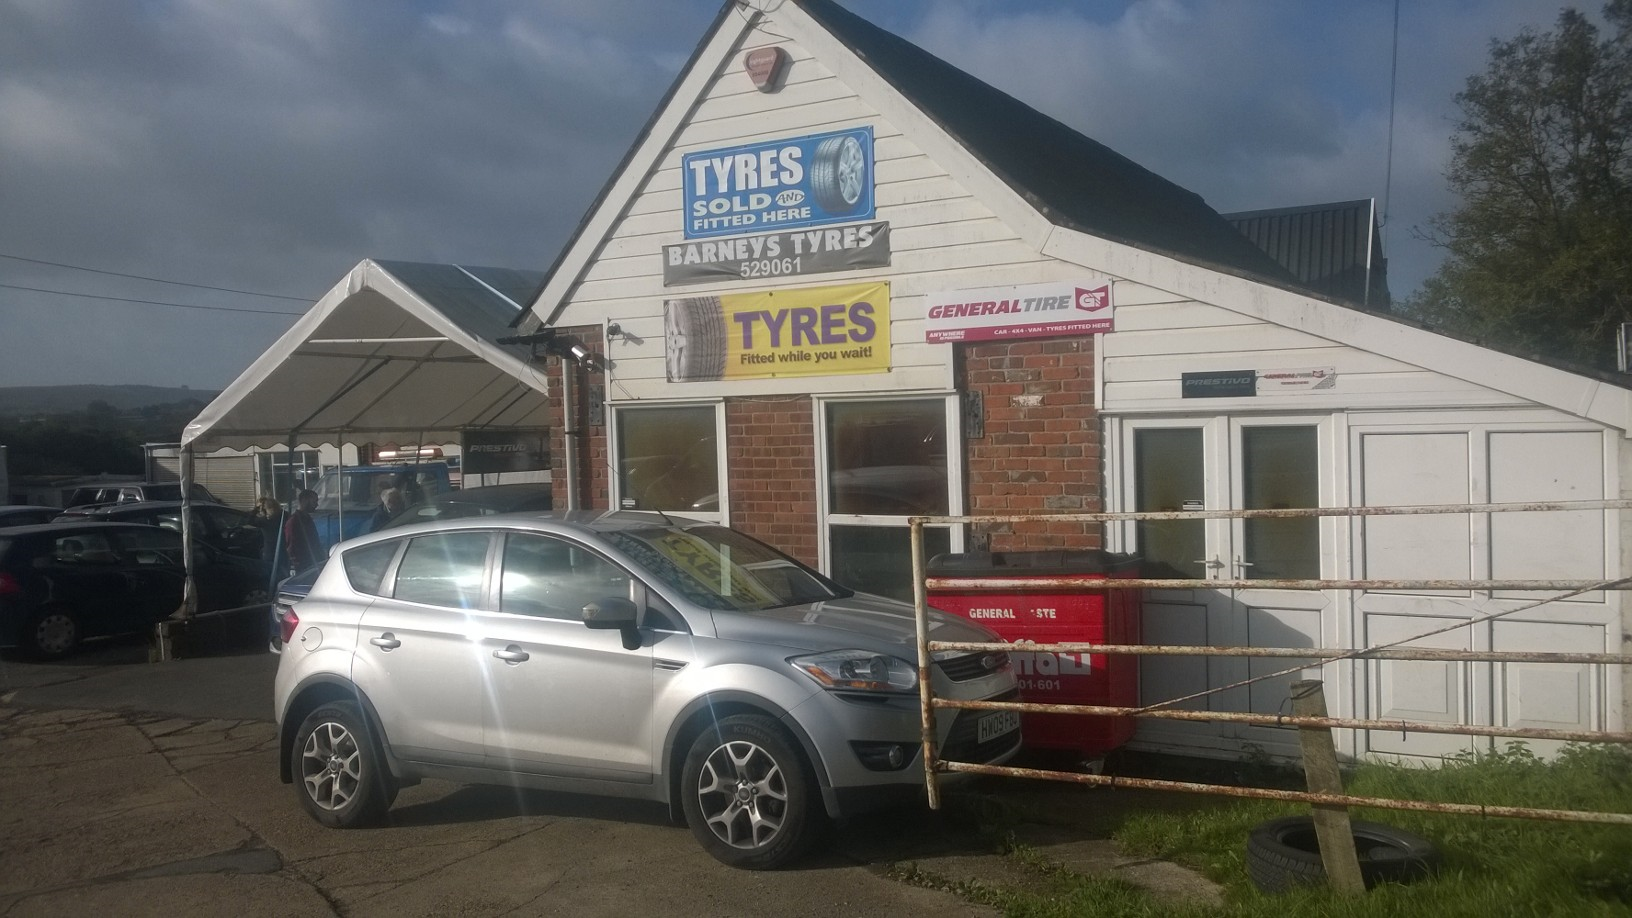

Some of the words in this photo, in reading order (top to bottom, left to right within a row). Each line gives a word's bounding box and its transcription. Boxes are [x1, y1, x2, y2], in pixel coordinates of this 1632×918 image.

[690, 146, 804, 196] TYRES
[693, 193, 772, 217] SOLD
[776, 191, 805, 204] AND
[694, 214, 756, 230] FITTED
[763, 207, 811, 222] HERE
[668, 236, 780, 266] BARNEYS
[790, 225, 873, 254] TYRES
[740, 257, 801, 278] 529061
[928, 299, 1022, 319] GENERAL
[1023, 295, 1072, 312] TIRE
[733, 301, 876, 350] TYRES
[1067, 323, 1092, 331] FITTED
[740, 351, 775, 365] Fitted
[779, 349, 811, 363] while
[814, 351, 837, 364] you
[841, 346, 872, 359] wait!
[969, 608, 1016, 619] GENERAL
[1029, 608, 1057, 619] STE
[733, 725, 772, 744] KUMHO
